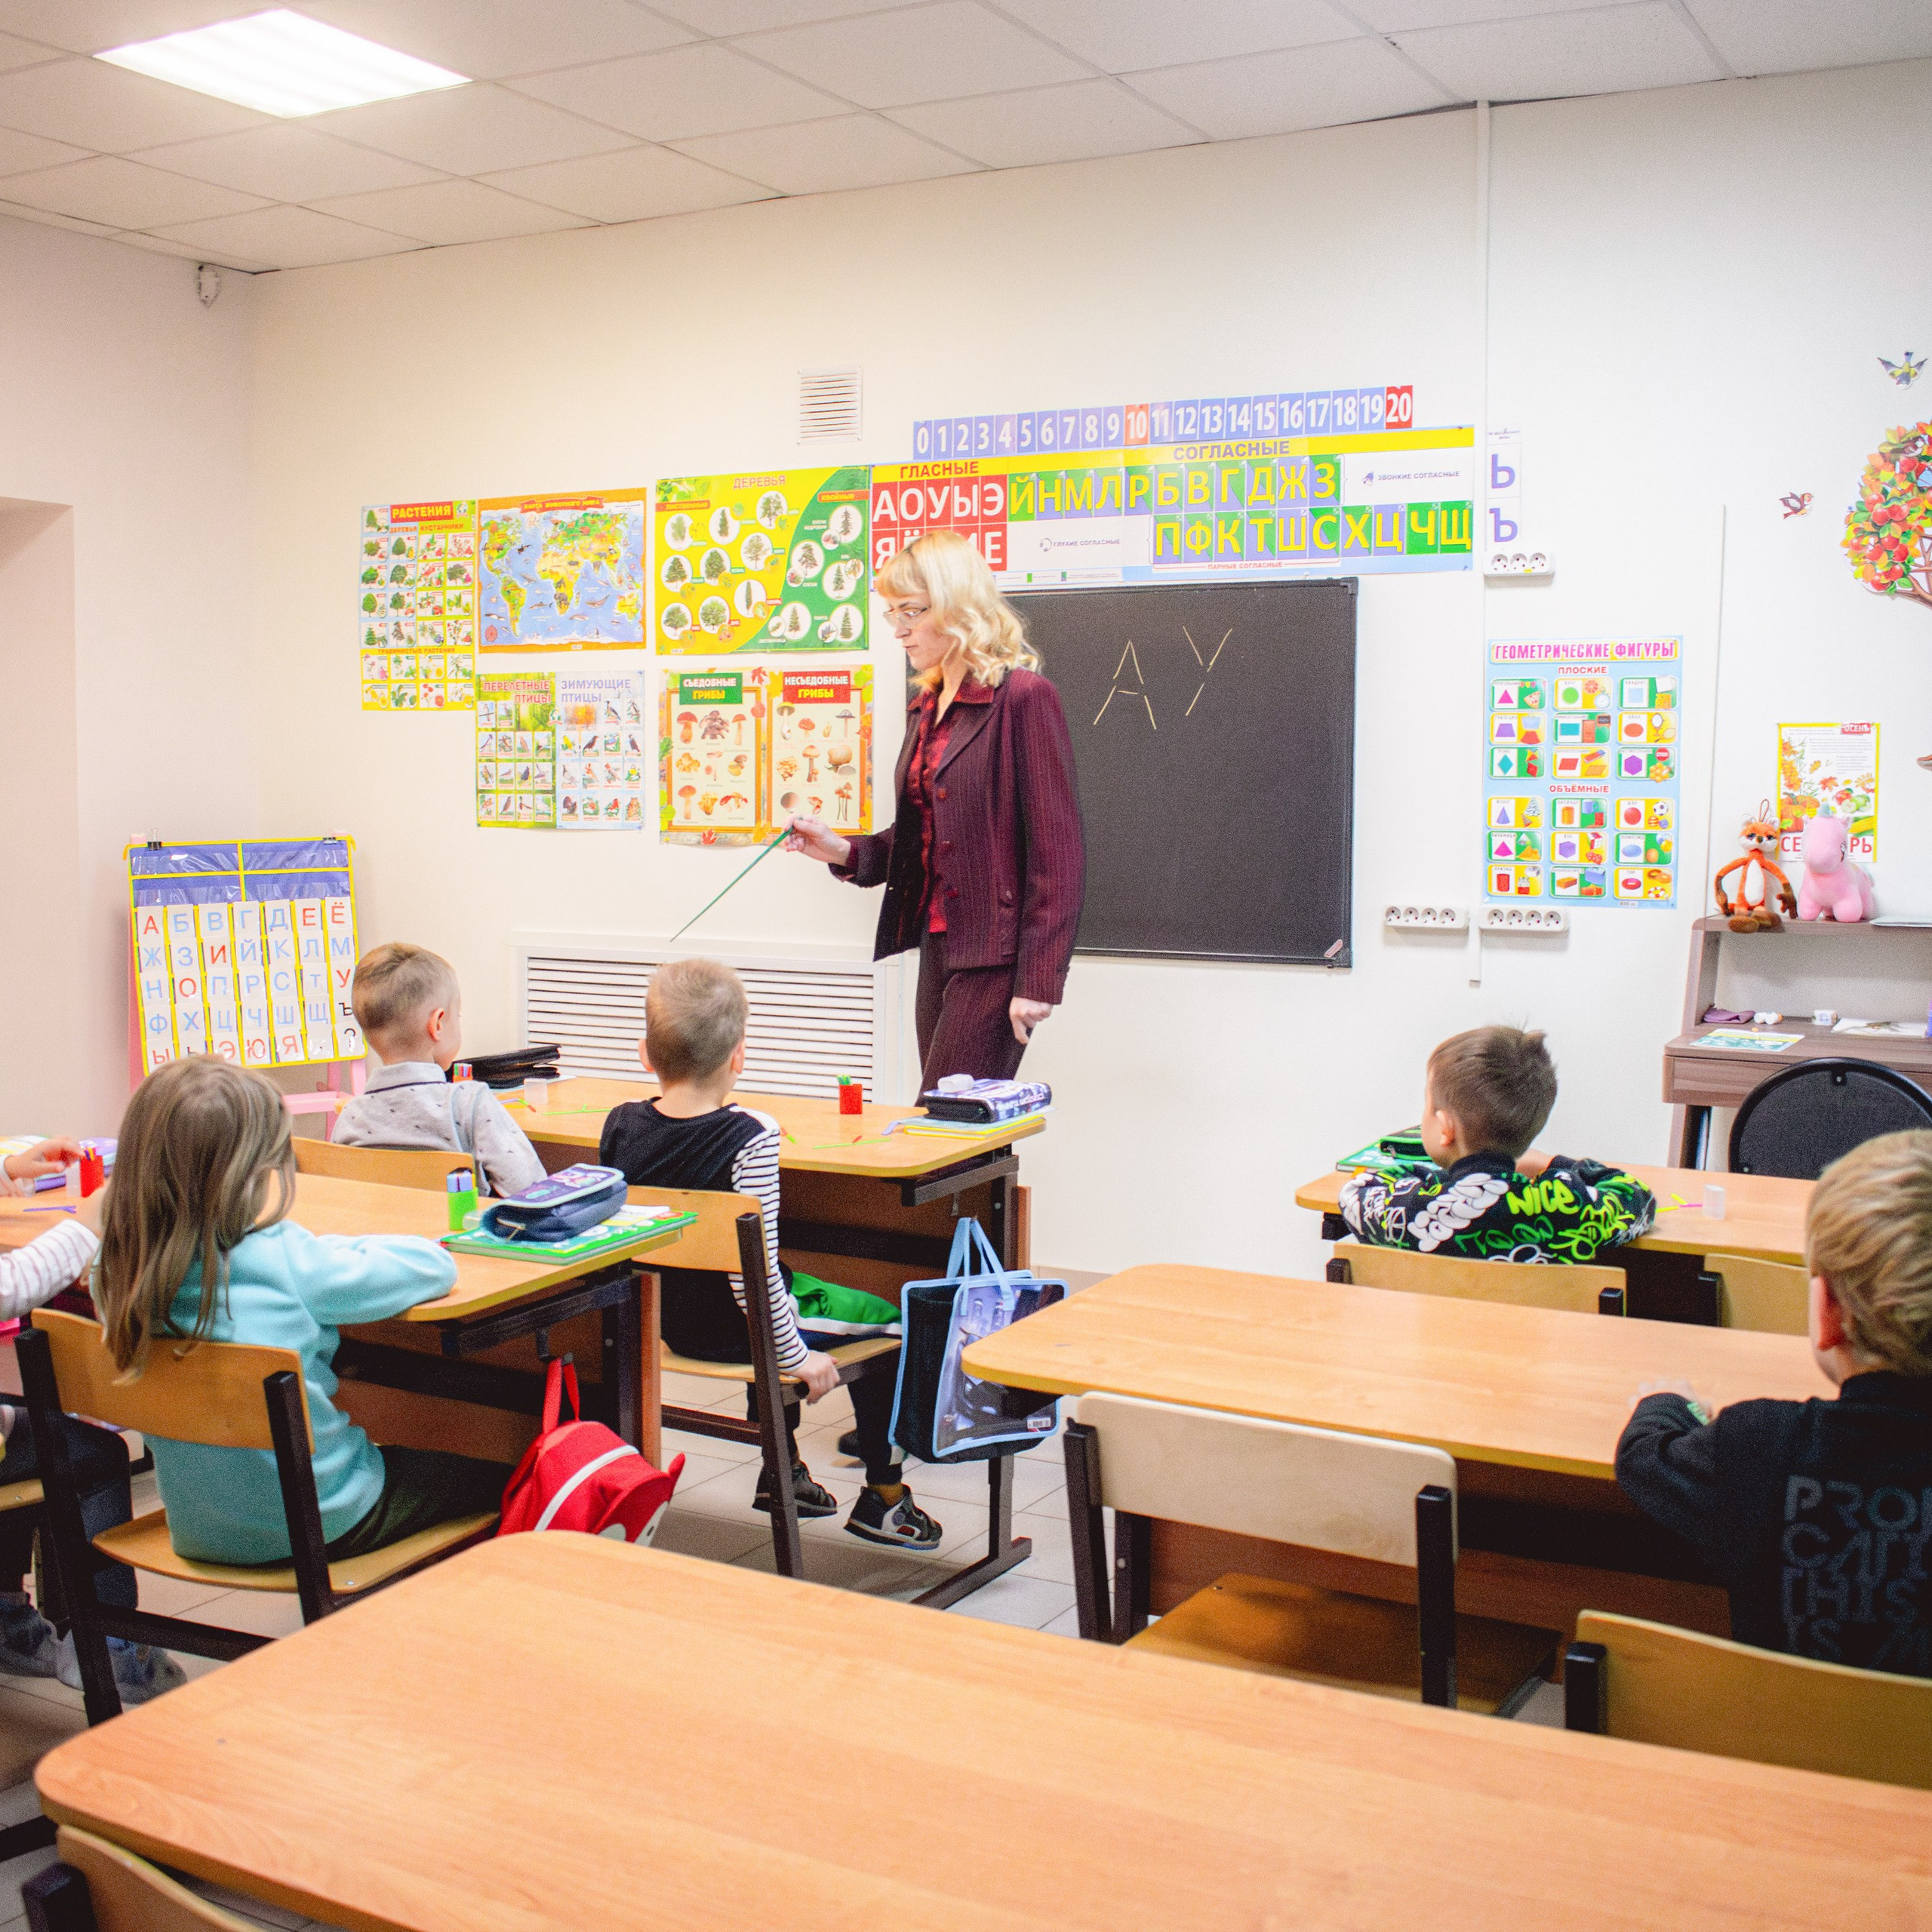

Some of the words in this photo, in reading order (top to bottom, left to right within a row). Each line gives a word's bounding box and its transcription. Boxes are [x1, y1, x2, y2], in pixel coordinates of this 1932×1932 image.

[917, 427, 929, 454] 0
[938, 426, 946, 451] 1
[956, 424, 969, 451] 2
[979, 422, 989, 449] 3
[999, 421, 1012, 448] 4
[1020, 420, 1032, 447] 5
[1041, 417, 1054, 445] 6
[1062, 416, 1075, 444] 7
[1084, 414, 1097, 442] 8
[1107, 413, 1119, 440] 9
[1127, 410, 1147, 438] 10
[1152, 408, 1170, 437] 11
[1175, 406, 1197, 435] 12
[1201, 405, 1223, 433] 13
[1227, 403, 1250, 432] 14
[1254, 401, 1276, 430] 15
[1280, 400, 1303, 429] 16
[1307, 398, 1329, 427] 17
[1334, 395, 1357, 426] 18
[1361, 395, 1383, 424] 19
[1386, 393, 1411, 423] 20
[1174, 441, 1290, 460] СОГЛАСНЫЕ
[900, 461, 979, 478] ГЛАСНЫЕ
[1414, 471, 1460, 479] СОГЛАСНЫЕ
[733, 475, 786, 490] ДЕРЕВЬЯ
[392, 505, 451, 518] РАСТЕНИЯ
[1489, 506, 1518, 543] Ъ
[1240, 561, 1283, 569] СОГЛАСНЫЕ
[1495, 643, 1610, 660] ГЕОМЕТРИЧЕСКИЕ
[1615, 642, 1674, 658] ФИГУРЫ
[1558, 666, 1607, 675] ПЛОСКИЕ
[561, 679, 631, 691] ЗИМУЮЩИЕ
[683, 677, 737, 688] СЪЕДОБНЫЕ
[784, 676, 849, 686] НЕСЪЕДОБНЫЕ
[515, 694, 552, 703] ПТИЦЫ
[561, 693, 601, 703] ПТИЦЫ
[692, 690, 725, 700] ГРИБЫ
[798, 689, 834, 699] ГРИБЫ
[1844, 723, 1870, 732] ОСЕНЬ
[1549, 783, 1610, 794] ОБЪЁМНЫЕ
[1780, 835, 1872, 854] СЕРЬ
[144, 915, 159, 934] А
[174, 914, 189, 933] Б
[208, 912, 223, 931] В
[240, 910, 253, 928] Г
[269, 909, 288, 931] Д
[303, 908, 316, 926] Е
[331, 902, 345, 924] Ё
[143, 948, 162, 966] Ж
[177, 947, 193, 966] З
[211, 945, 226, 964] И
[242, 939, 257, 962] Й
[275, 939, 290, 958] К
[303, 939, 319, 958] Л
[331, 937, 350, 956] М
[146, 980, 163, 999] Н
[179, 978, 197, 998] О
[212, 977, 227, 995] П
[246, 974, 260, 994] Р
[274, 971, 290, 991] С
[337, 969, 351, 988] У
[149, 1014, 168, 1034] Ф
[183, 1011, 200, 1031] Х
[218, 1011, 232, 1032] Ц
[248, 1008, 262, 1026] Ч
[276, 1005, 294, 1024] Ш
[308, 1003, 328, 1024] Щ
[152, 1048, 171, 1065] Ы
[218, 1041, 235, 1060] Э
[247, 1038, 266, 1060] Ю
[281, 1035, 298, 1054] Я
[1784, 1475, 1932, 1533] PRO
